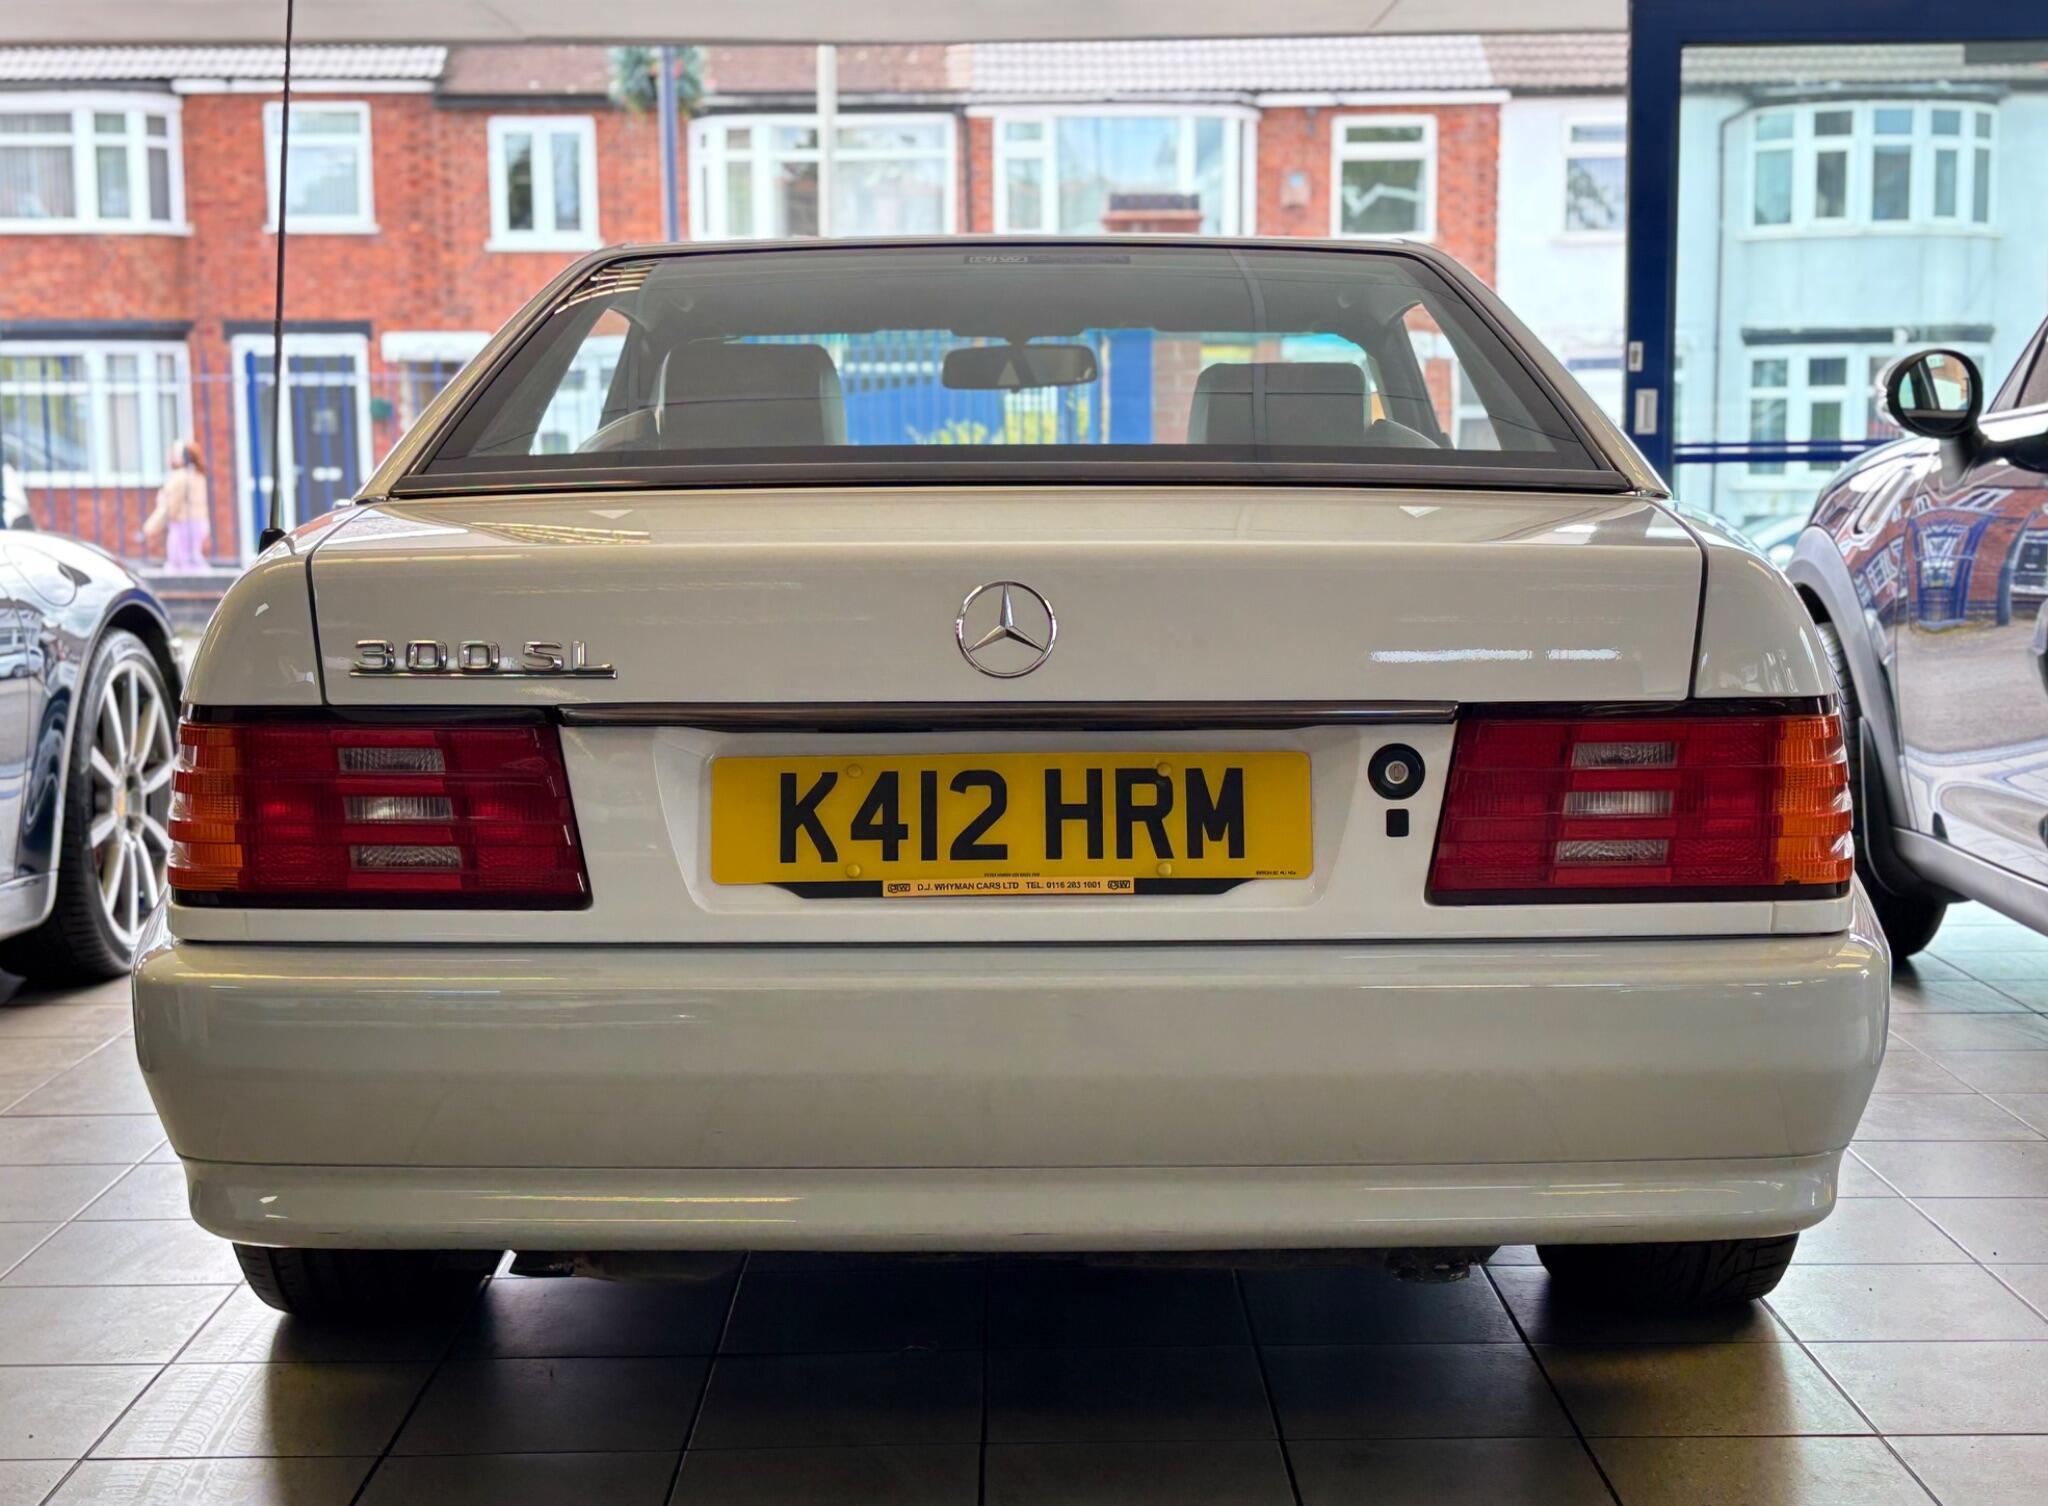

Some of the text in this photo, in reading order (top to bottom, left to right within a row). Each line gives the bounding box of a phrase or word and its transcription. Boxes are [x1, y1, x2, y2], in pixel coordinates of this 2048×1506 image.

[353, 639, 613, 671] 300 SL
[779, 767, 1245, 864] K412 HRM
[934, 882, 974, 891] WHYMAN
[976, 881, 1001, 890] CARS
[1002, 881, 1019, 889] LTD
[1046, 881, 1065, 889] 0116
[1083, 880, 1101, 889] 1001
